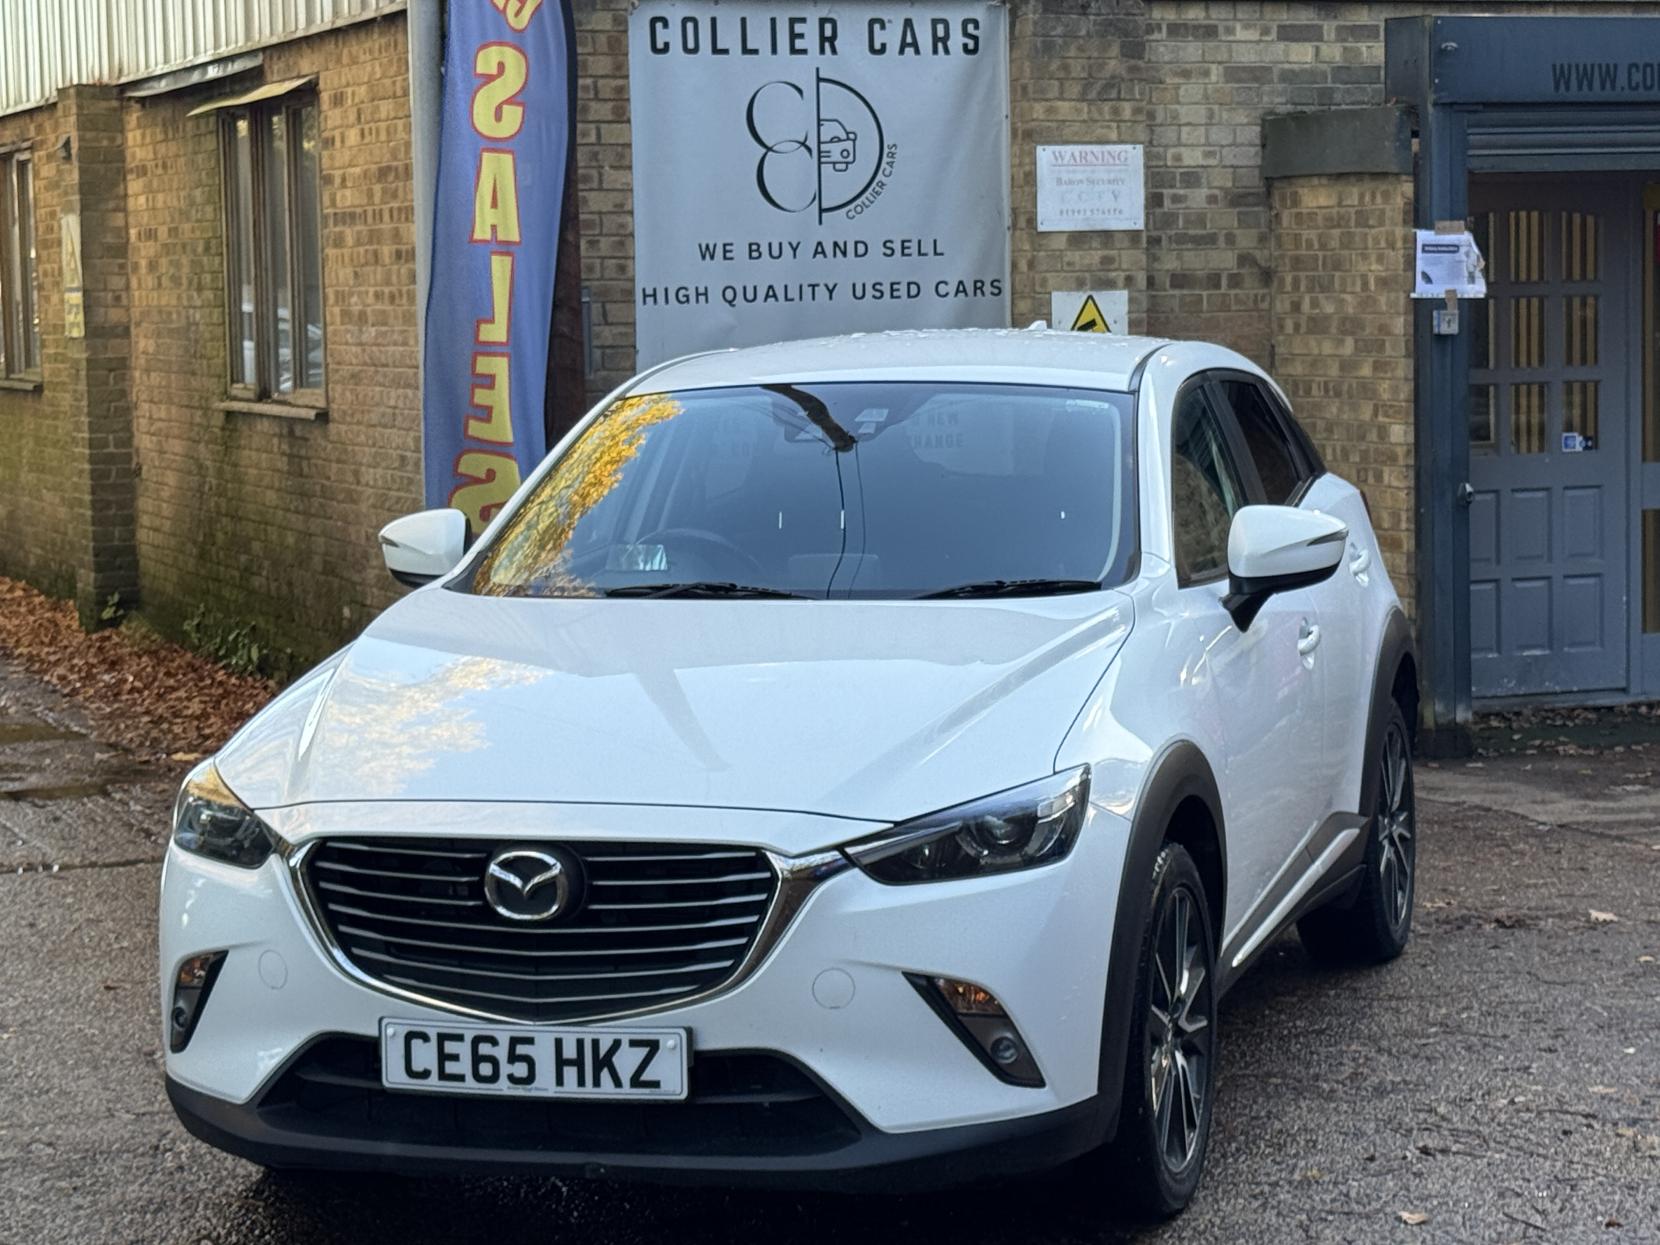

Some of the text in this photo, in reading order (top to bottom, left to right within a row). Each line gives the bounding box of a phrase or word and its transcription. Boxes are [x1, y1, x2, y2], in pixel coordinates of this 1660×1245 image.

[649, 16, 981, 57] COLLIER CARS
[1552, 63, 1660, 93] WWW.CO
[1051, 150, 1129, 164] WARNING
[845, 143, 898, 220] COLLIER CARS
[698, 239, 945, 261] WE BUY AND SELL
[642, 279, 1003, 308] HIGH QUALITY USED CARS
[403, 1030, 661, 1090] CE65 HKZ
